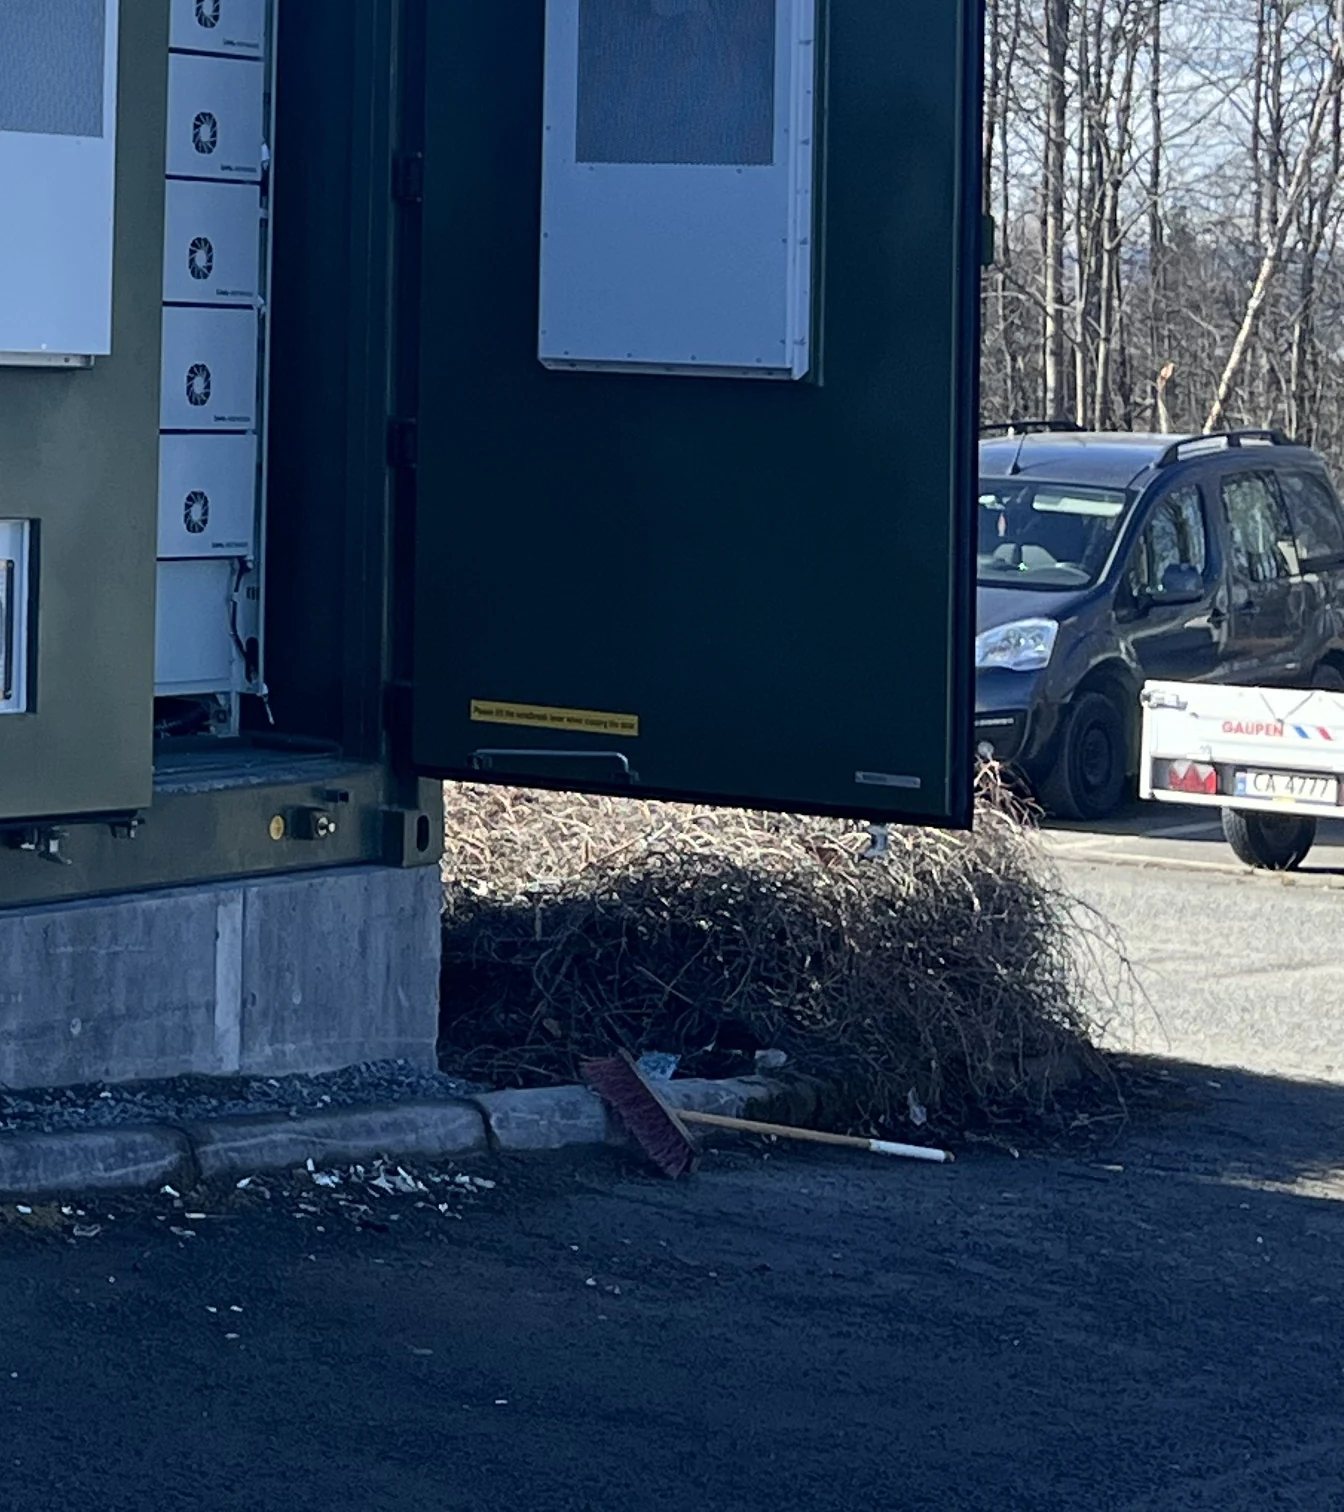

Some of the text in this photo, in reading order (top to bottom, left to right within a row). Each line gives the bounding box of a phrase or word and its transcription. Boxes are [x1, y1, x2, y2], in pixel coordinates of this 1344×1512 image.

[1222, 720, 1284, 738] GAUPEN
[1253, 772, 1330, 798] CA 4777
